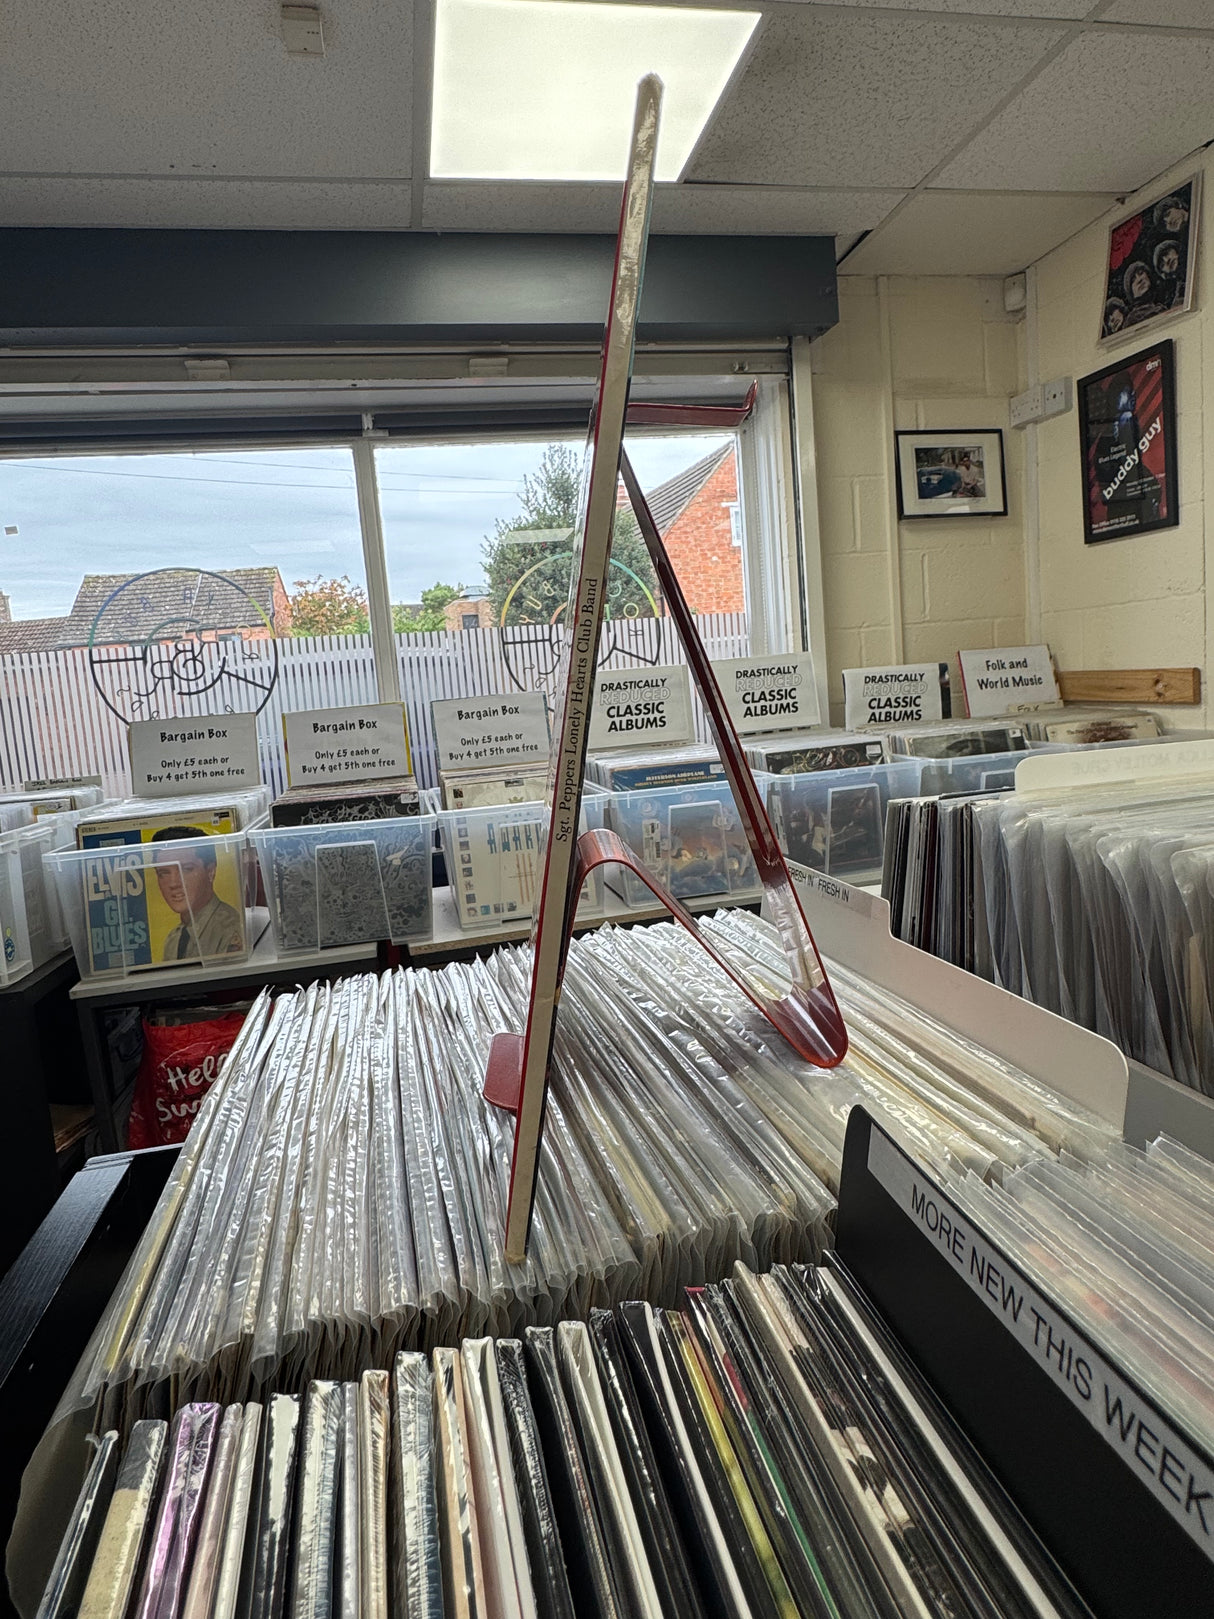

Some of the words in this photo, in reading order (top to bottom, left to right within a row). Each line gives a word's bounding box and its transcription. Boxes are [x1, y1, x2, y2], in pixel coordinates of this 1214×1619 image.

[1102, 448, 1139, 500] buddy
[1138, 416, 1162, 452] guy
[582, 578, 598, 616] Band
[577, 619, 592, 653] Club
[736, 665, 798, 678] DRASTICALLY
[986, 659, 1006, 672] Folk
[1008, 658, 1028, 669] and
[570, 658, 588, 703] Hearts
[600, 678, 667, 692] DRASTICALLY
[736, 674, 803, 692] REDUCED
[864, 672, 926, 684] DRASTICALLY
[977, 676, 1010, 690] World
[1012, 674, 1044, 688] Music
[600, 687, 672, 706] REDUCED
[742, 688, 796, 704] CLASSIC
[863, 680, 928, 698] REDUCED
[606, 702, 664, 718] CLASSIC
[744, 702, 798, 718] ALBUMS
[868, 696, 922, 710] CLASSIC
[457, 707, 498, 720] Bargain
[501, 706, 520, 716] Box
[867, 710, 922, 724] ALBUMS
[312, 721, 356, 734] Bargain
[358, 720, 378, 730] Box
[565, 706, 584, 756] Lonely
[608, 716, 666, 732] ALBUMS
[160, 730, 204, 742] Bargain
[208, 728, 228, 738] Box
[460, 737, 479, 746] Only
[482, 735, 492, 744] £5
[494, 733, 512, 742] each
[315, 751, 334, 760] Only
[337, 749, 348, 758] £5
[350, 747, 370, 756] each
[448, 752, 464, 760] Buy
[466, 750, 472, 758] 4
[474, 749, 487, 758] get
[490, 747, 504, 756] 5th
[522, 744, 538, 752] free
[161, 760, 181, 768] Only
[184, 758, 195, 766] £5
[198, 756, 218, 765] each
[302, 765, 317, 774] Buy
[328, 762, 342, 772] get
[345, 760, 360, 770] 5th
[378, 758, 396, 766] free
[146, 774, 162, 782] Buy
[166, 772, 172, 780] 4
[175, 772, 188, 782] get
[192, 770, 208, 778] 5th
[559, 758, 577, 811] Peppers
[556, 817, 572, 842] Sgt.
[788, 866, 806, 882] FRESH
[808, 874, 814, 886] IN
[818, 879, 840, 898] FRESH
[842, 890, 850, 902] IN
[91, 921, 147, 954] BLUES
[911, 1183, 966, 1264] MORE
[970, 1246, 1024, 1323] NEW
[1030, 1306, 1093, 1400] THIS
[1104, 1384, 1214, 1536] WEEK
